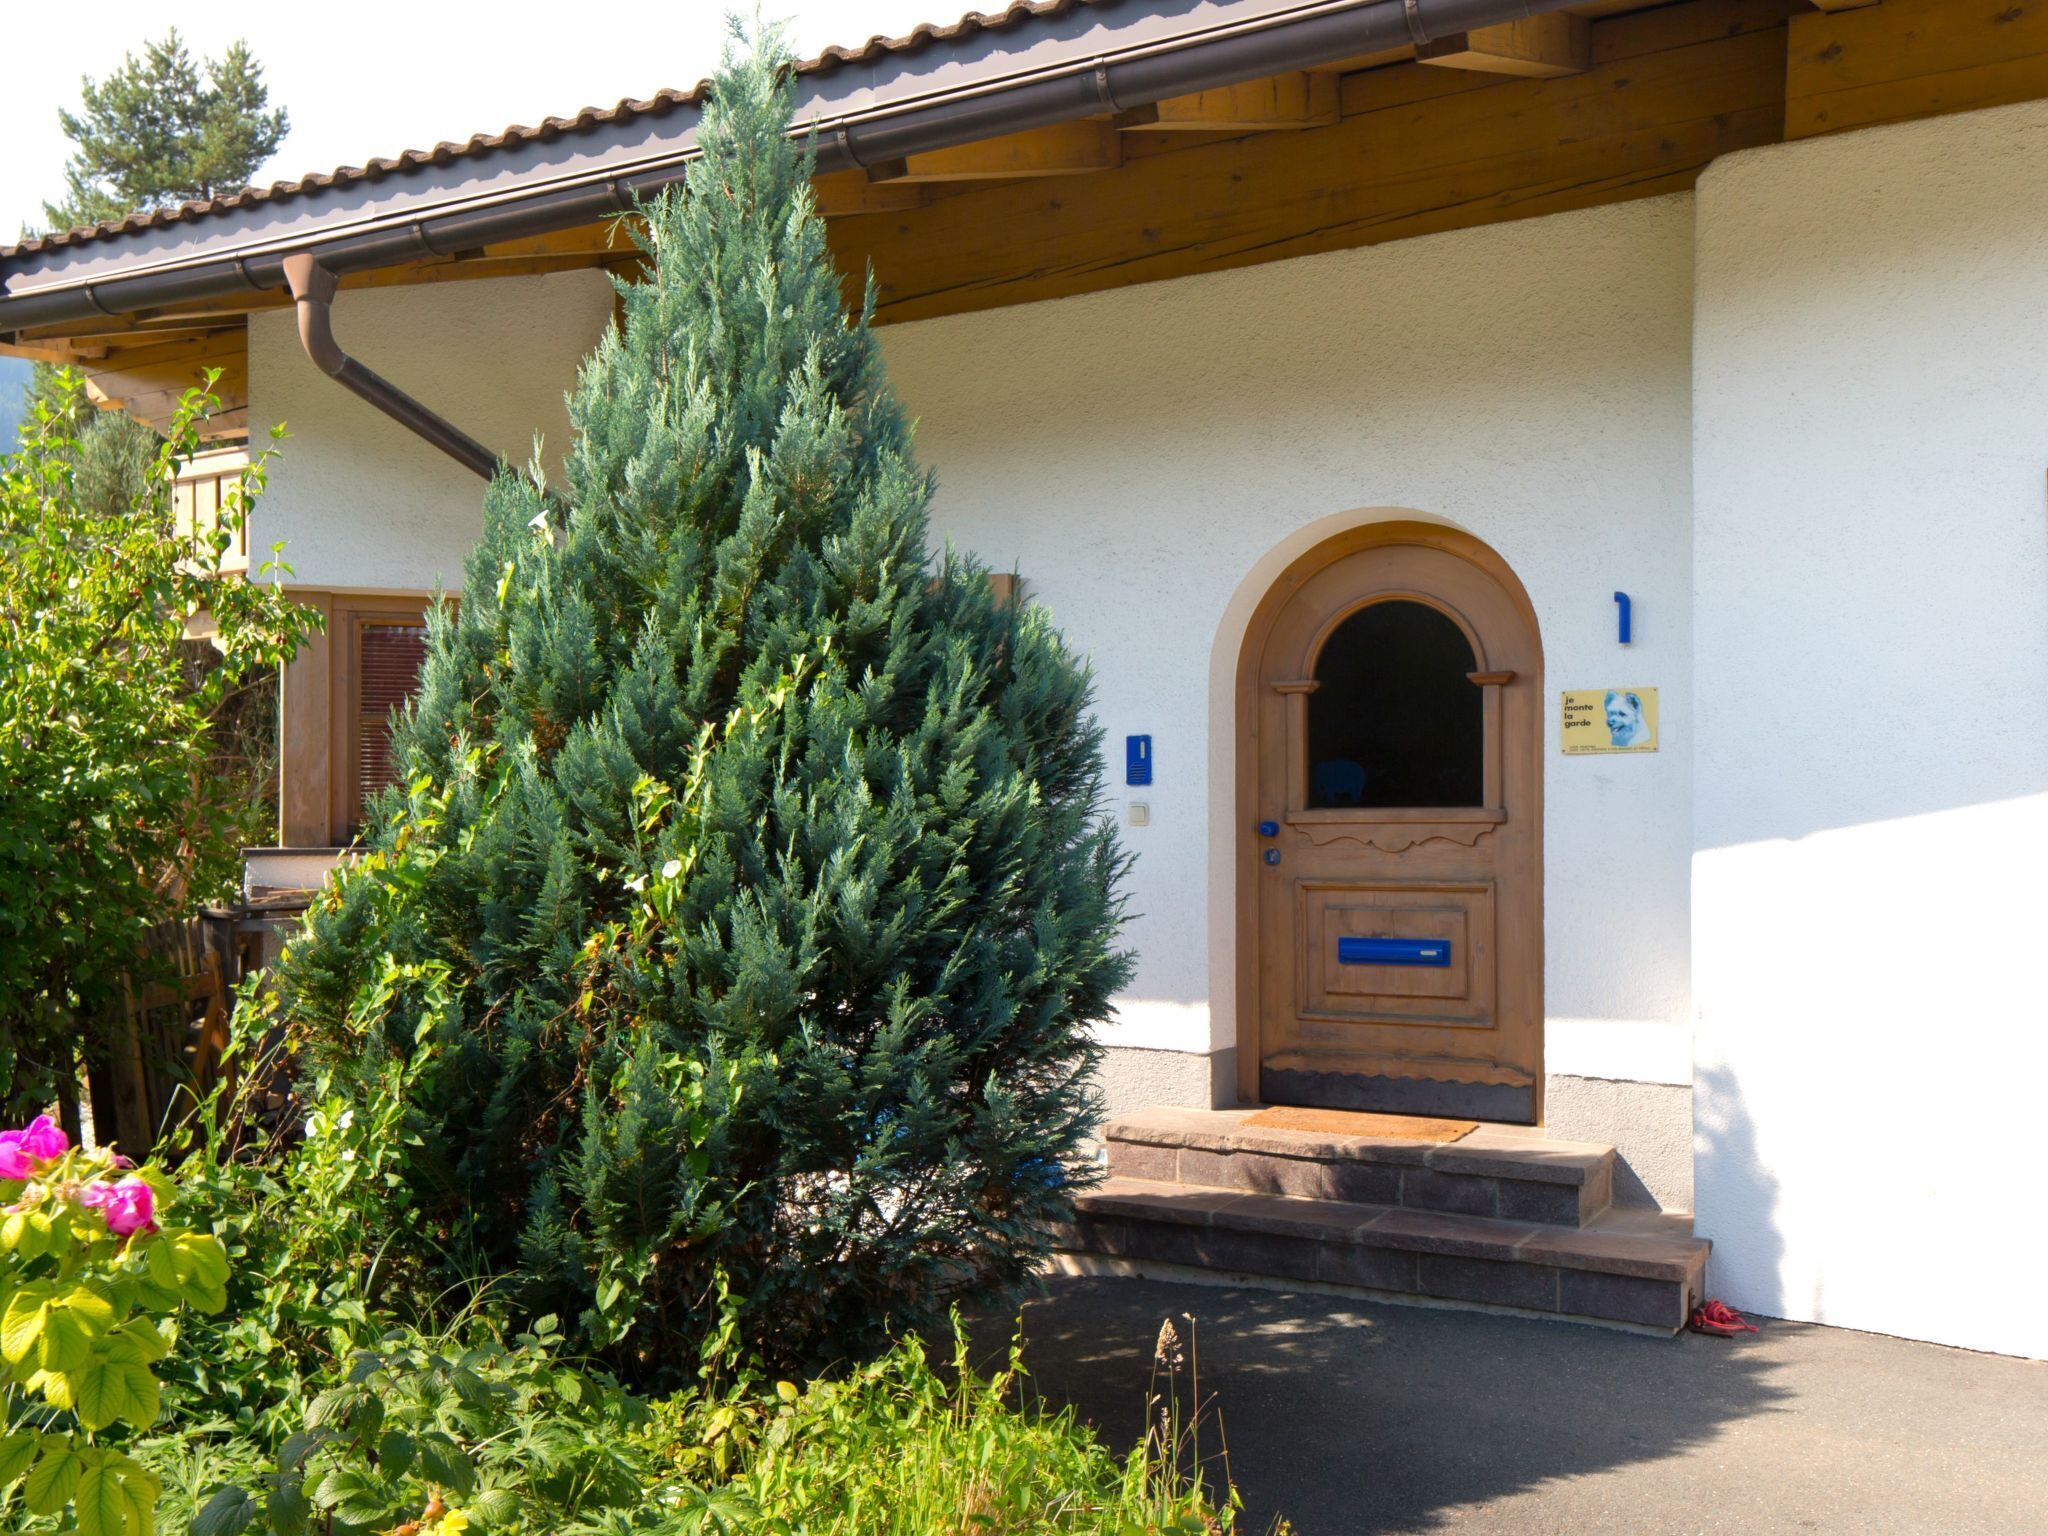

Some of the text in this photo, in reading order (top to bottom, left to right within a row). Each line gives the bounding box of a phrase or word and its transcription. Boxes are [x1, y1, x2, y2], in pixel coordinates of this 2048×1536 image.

[1614, 591, 1631, 643] 1
[1565, 696, 1574, 705] je
[1564, 712, 1573, 720] la
[1564, 719, 1592, 728] garde
